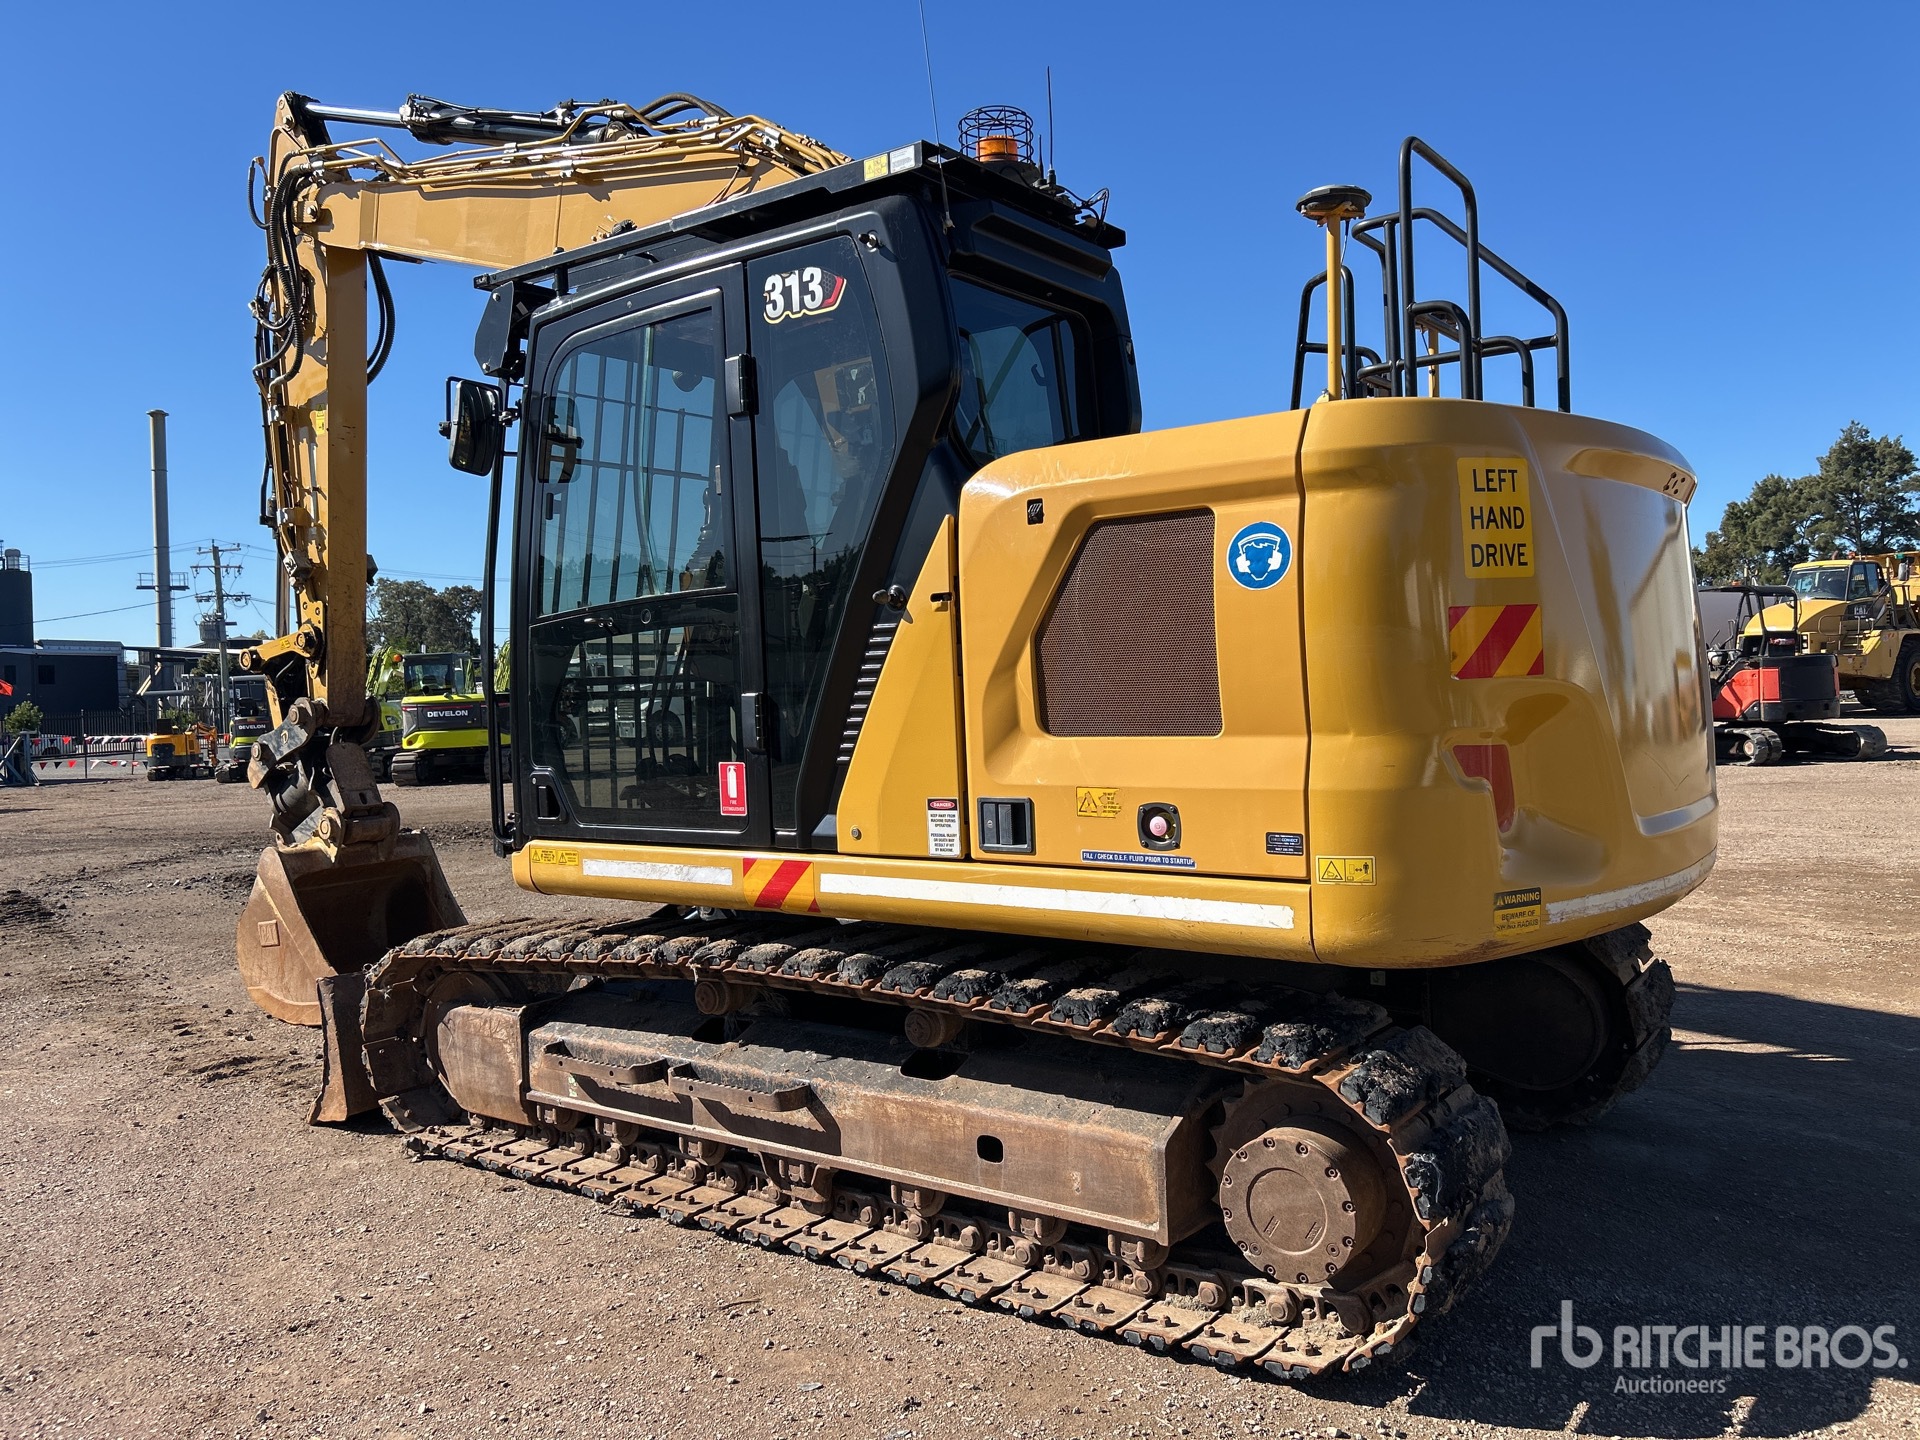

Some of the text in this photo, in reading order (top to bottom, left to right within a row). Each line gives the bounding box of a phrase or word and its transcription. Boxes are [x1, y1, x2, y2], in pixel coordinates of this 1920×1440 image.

[764, 266, 823, 318] 313
[1472, 468, 1518, 492] LEFT
[1470, 506, 1525, 529] HAND
[1471, 543, 1528, 567] DRIVE
[427, 710, 468, 718] DEVELON
[1504, 892, 1539, 904] WARNING
[1501, 911, 1526, 921] BEWARE
[1517, 919, 1538, 928] RADIUS
